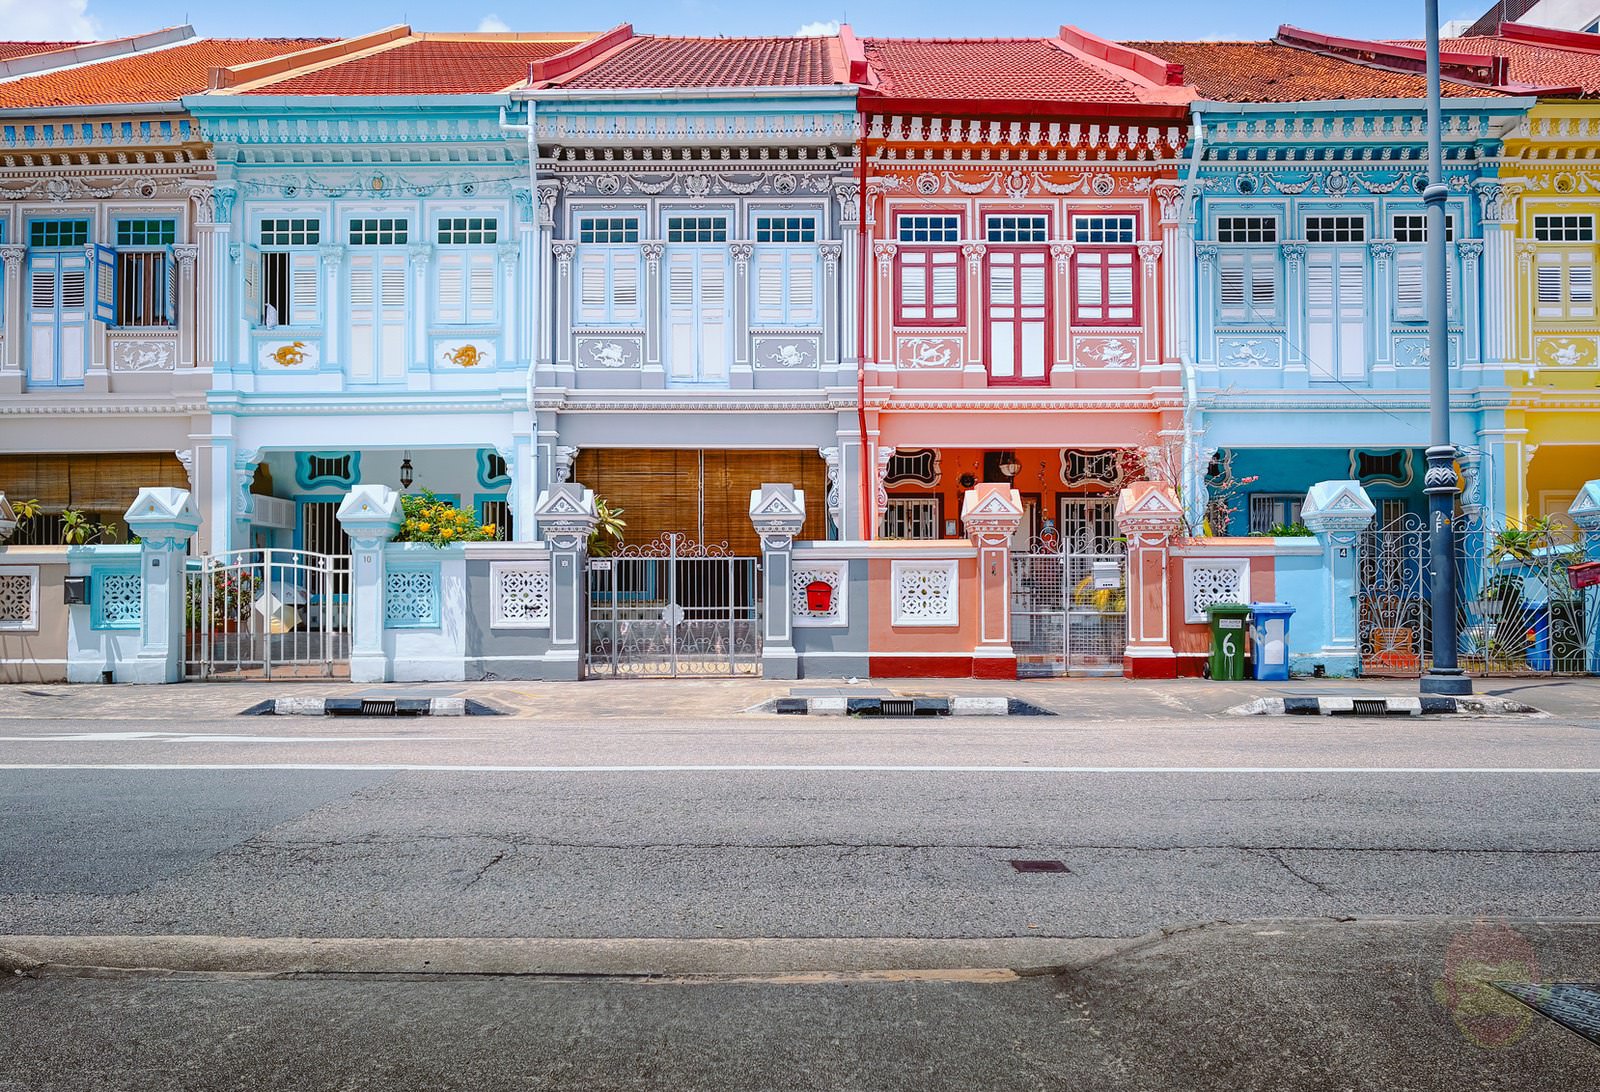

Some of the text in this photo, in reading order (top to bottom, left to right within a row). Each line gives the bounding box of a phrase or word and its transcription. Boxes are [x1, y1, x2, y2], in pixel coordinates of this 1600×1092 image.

[1340, 548, 1347, 557] 4
[363, 555, 372, 563] 10
[1222, 632, 1236, 657] 6
